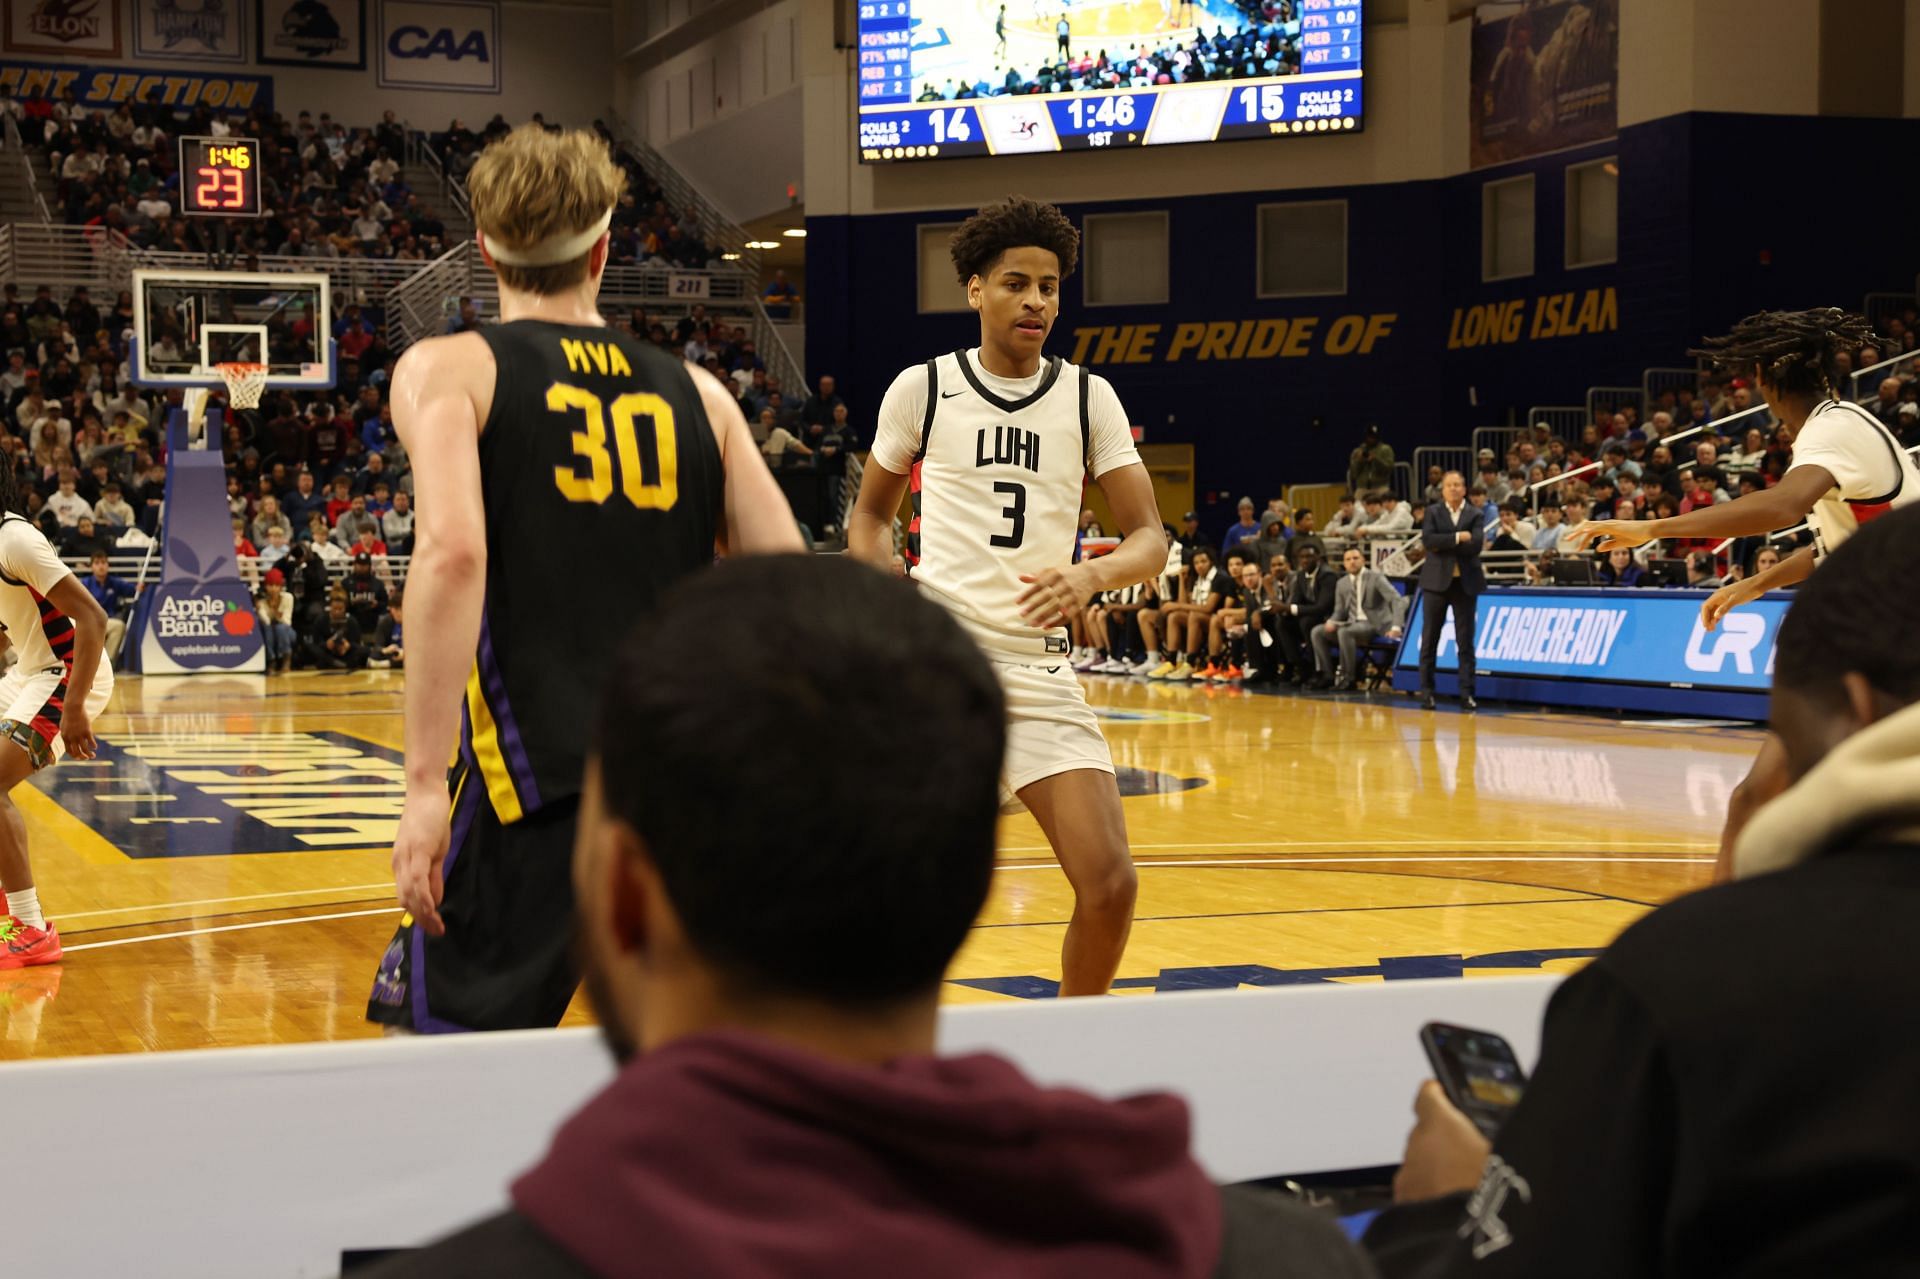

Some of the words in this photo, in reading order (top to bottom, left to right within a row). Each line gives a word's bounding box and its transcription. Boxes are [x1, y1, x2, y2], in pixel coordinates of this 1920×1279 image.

[35, 15, 98, 36] ELON
[1336, 10, 1356, 24] 0.0
[388, 25, 489, 63] CAA
[1304, 31, 1330, 45] REB
[1342, 29, 1351, 41] 7
[1304, 49, 1330, 63] AST
[1342, 46, 1351, 59] 3
[86, 73, 259, 108] SECTION
[861, 83, 884, 96] AST
[894, 81, 902, 94] 2
[1300, 90, 1341, 104] FOULS
[1344, 89, 1353, 102] 2
[1068, 95, 1135, 129] 1:46
[1240, 84, 1284, 122] 15
[1296, 103, 1341, 117] BONUS
[860, 121, 898, 134] FOULS
[901, 120, 910, 133] 2
[929, 108, 970, 143] 14
[860, 133, 900, 147] BONUS
[1088, 131, 1113, 146] 1ST
[210, 146, 250, 169] 1:46
[197, 167, 244, 208] 23
[676, 279, 701, 293] 211
[1448, 300, 1525, 349] LONG
[1072, 324, 1161, 364] THE
[1165, 317, 1319, 361] PRIDE
[1324, 313, 1397, 355] OF
[560, 337, 632, 377] MVA
[546, 381, 678, 512] 30
[976, 426, 1040, 473] LUHI
[990, 481, 1026, 548] 3
[158, 595, 225, 620] Apple
[158, 616, 220, 637] Bank
[1475, 606, 1627, 667] LEAGUEREADY
[172, 645, 241, 656] applebank.com
